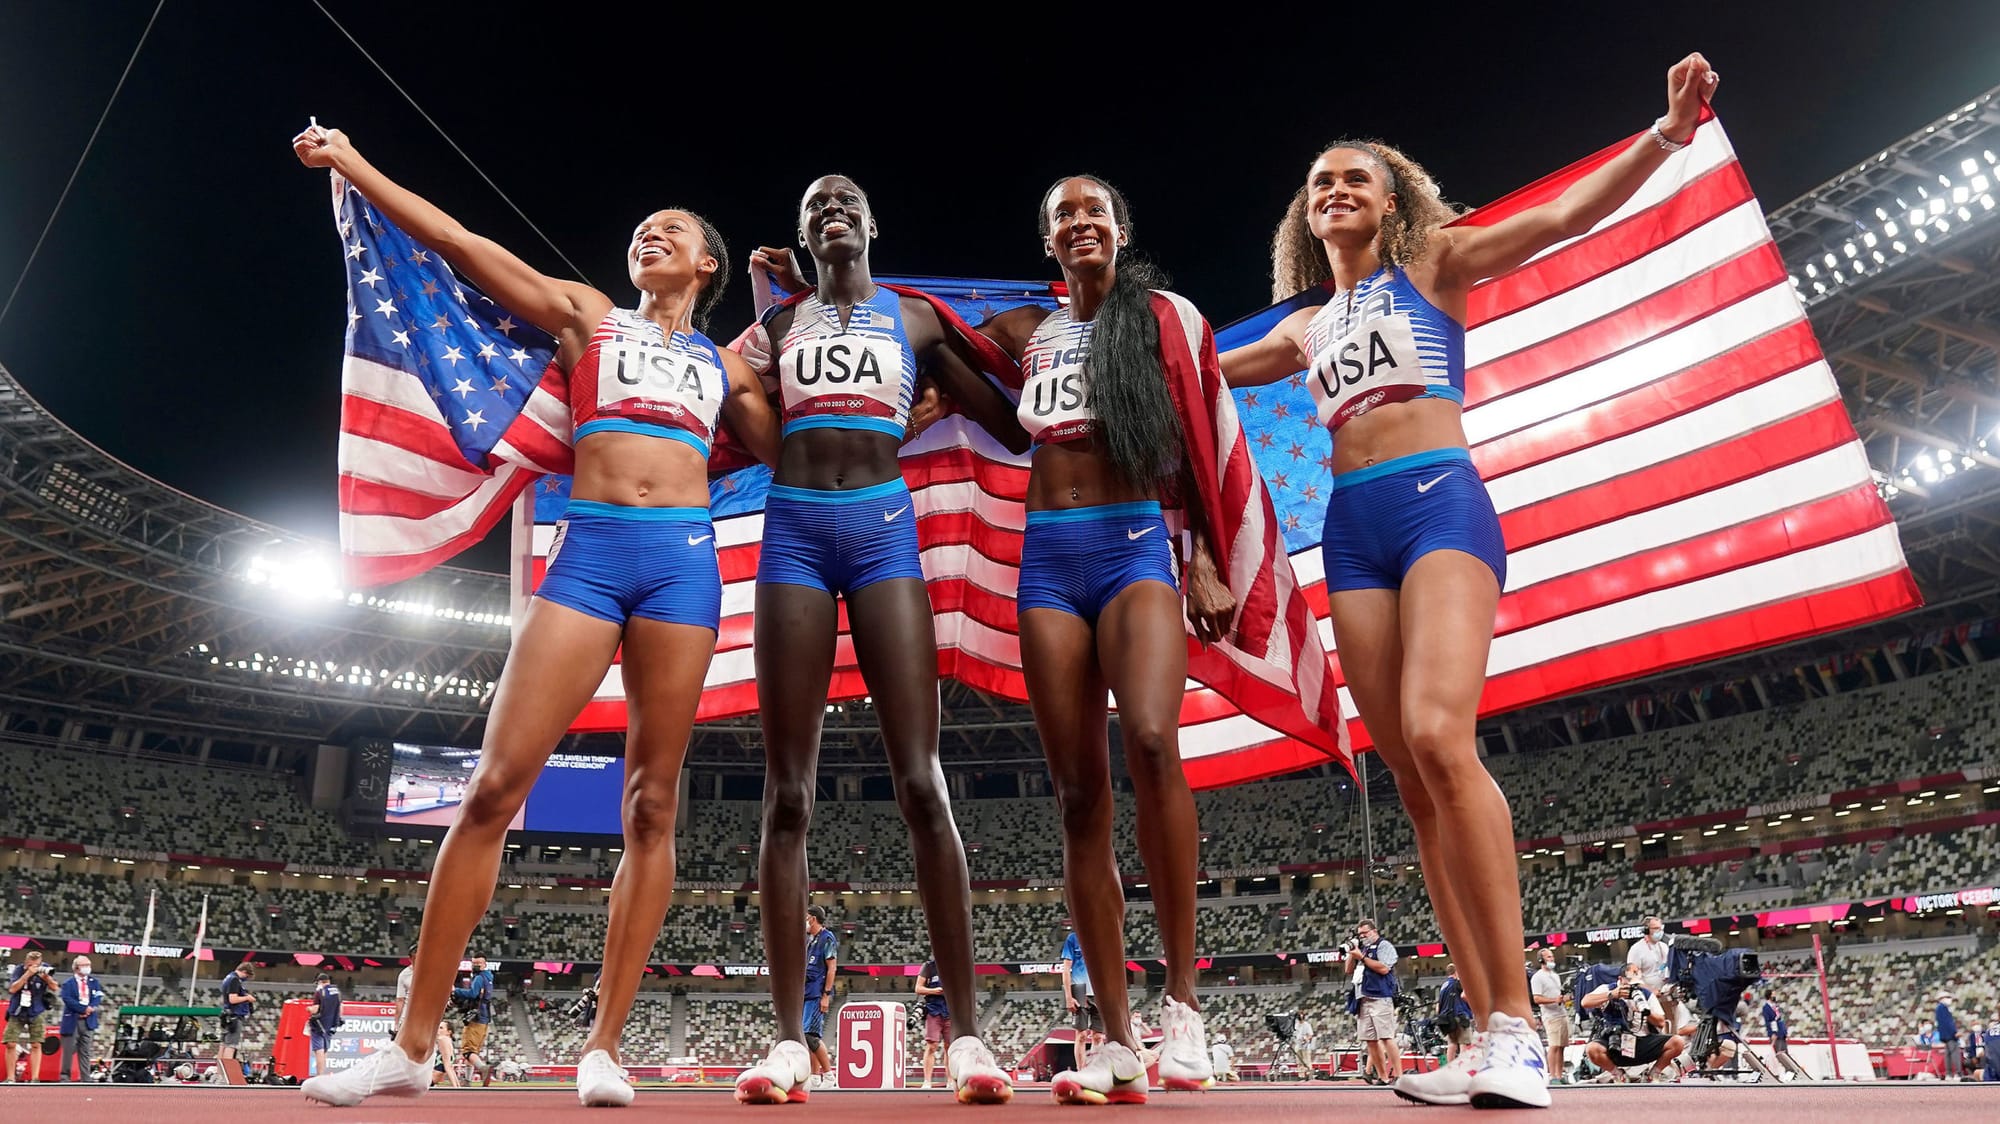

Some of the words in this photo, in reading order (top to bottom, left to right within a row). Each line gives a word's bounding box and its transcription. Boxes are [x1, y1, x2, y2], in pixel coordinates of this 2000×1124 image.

[796, 344, 883, 385] USA
[1318, 330, 1398, 398] USA
[617, 350, 704, 401] USA
[1033, 373, 1091, 417] US
[570, 761, 606, 769] CEREMONY
[1915, 892, 1960, 909] VICTORY
[1586, 928, 1620, 942] VICTORY
[94, 943, 133, 955] VICTORY
[1307, 951, 1340, 963] VICTORY
[724, 966, 759, 976] VICTORY
[1020, 963, 1053, 973] VICTORY
[842, 1010, 864, 1020] TOKYO
[865, 1010, 881, 1018] 2020
[848, 1020, 874, 1078] 5
[894, 1021, 902, 1078] 5
